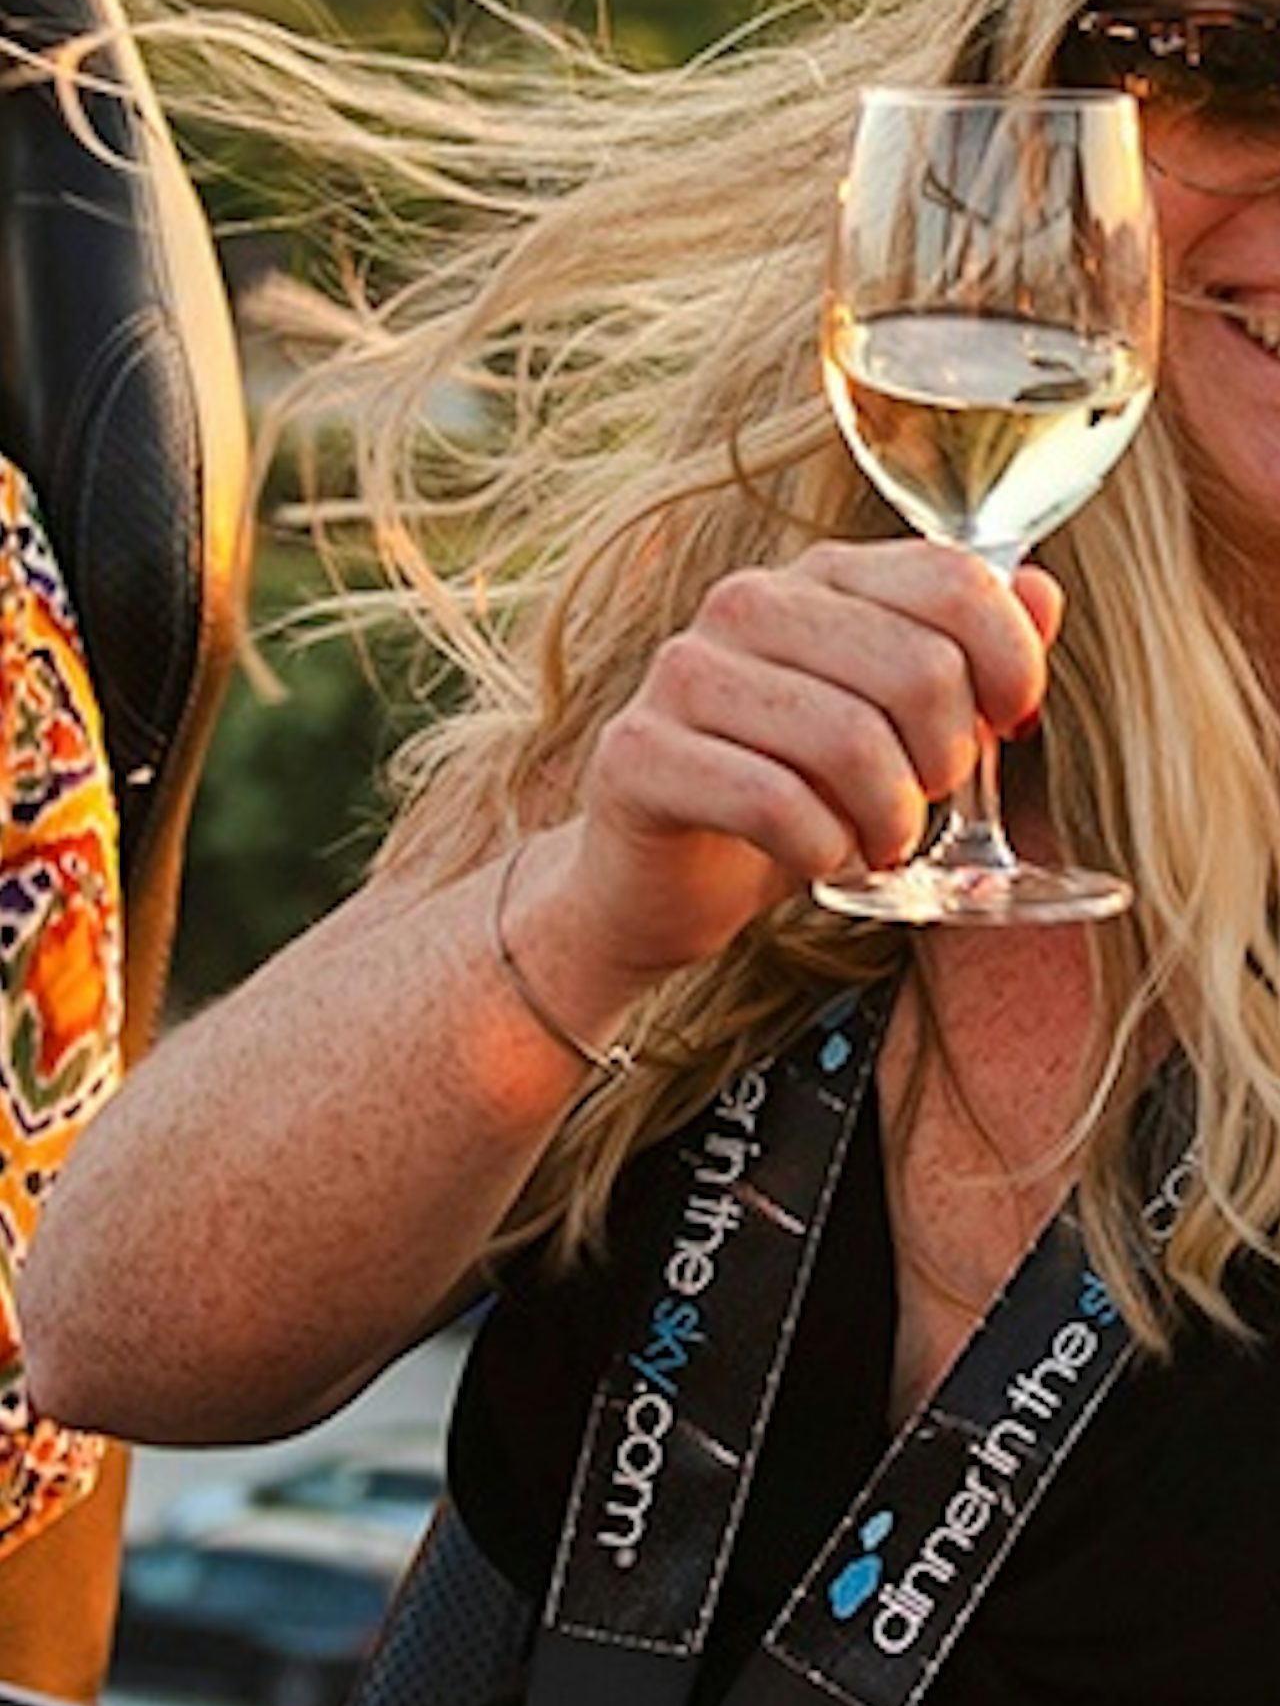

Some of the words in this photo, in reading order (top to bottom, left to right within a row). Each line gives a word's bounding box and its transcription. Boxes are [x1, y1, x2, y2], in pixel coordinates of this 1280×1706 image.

[664, 1194, 741, 1295] the
[873, 1466, 998, 1654] dinner
[969, 1420, 1037, 1476] in
[1006, 1321, 1098, 1419] the
